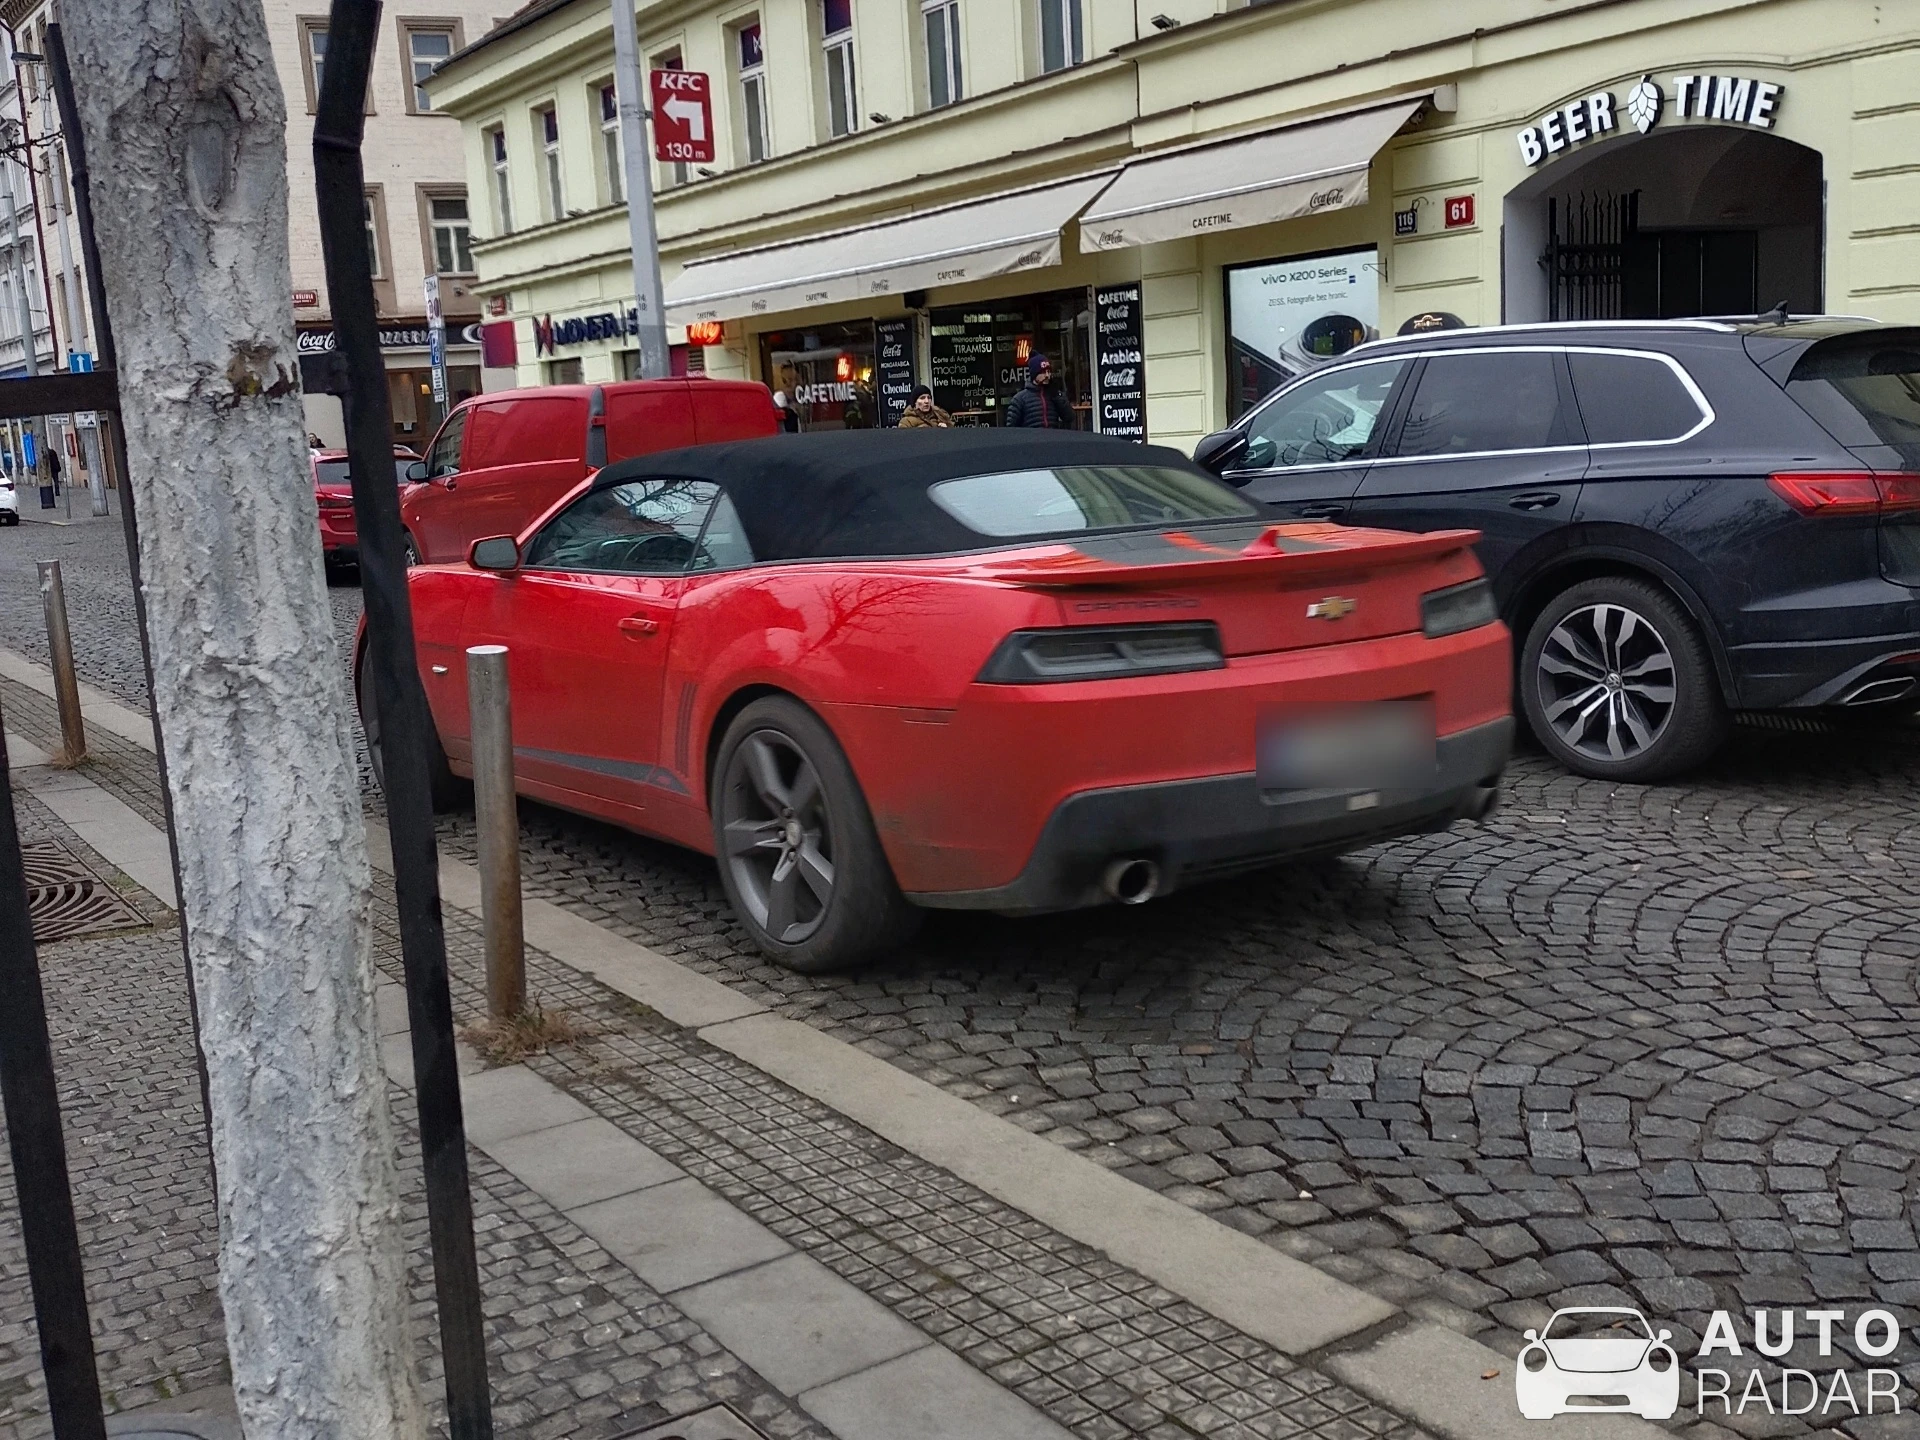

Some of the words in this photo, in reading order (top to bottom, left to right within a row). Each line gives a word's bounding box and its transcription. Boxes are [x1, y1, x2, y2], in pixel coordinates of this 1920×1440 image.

[660, 73, 703, 91] KFC
[1517, 92, 1616, 167] BEER
[1673, 75, 1783, 128] TIME
[666, 142, 693, 158] 130
[1451, 201, 1466, 220] 61
[1192, 213, 1232, 229] CAFETIME
[1398, 212, 1413, 227] 116
[937, 269, 965, 280] CAFETIME
[1261, 274, 1287, 285] vivo
[1289, 270, 1316, 281] X200
[1318, 267, 1347, 278] Series
[1098, 289, 1138, 305] CAFETIME
[954, 343, 992, 354] TIRAMISU
[1017, 340, 1032, 361] illy
[1101, 349, 1141, 365] Arabica
[933, 363, 967, 375] mocha
[882, 382, 912, 394] Chocolat
[934, 376, 949, 387] live
[795, 381, 857, 404] CAFETIME
[964, 387, 995, 397] arabica
[887, 397, 907, 410] Cappy
[1103, 427, 1117, 436] LIVE
[1076, 599, 1199, 614] CAMARO
